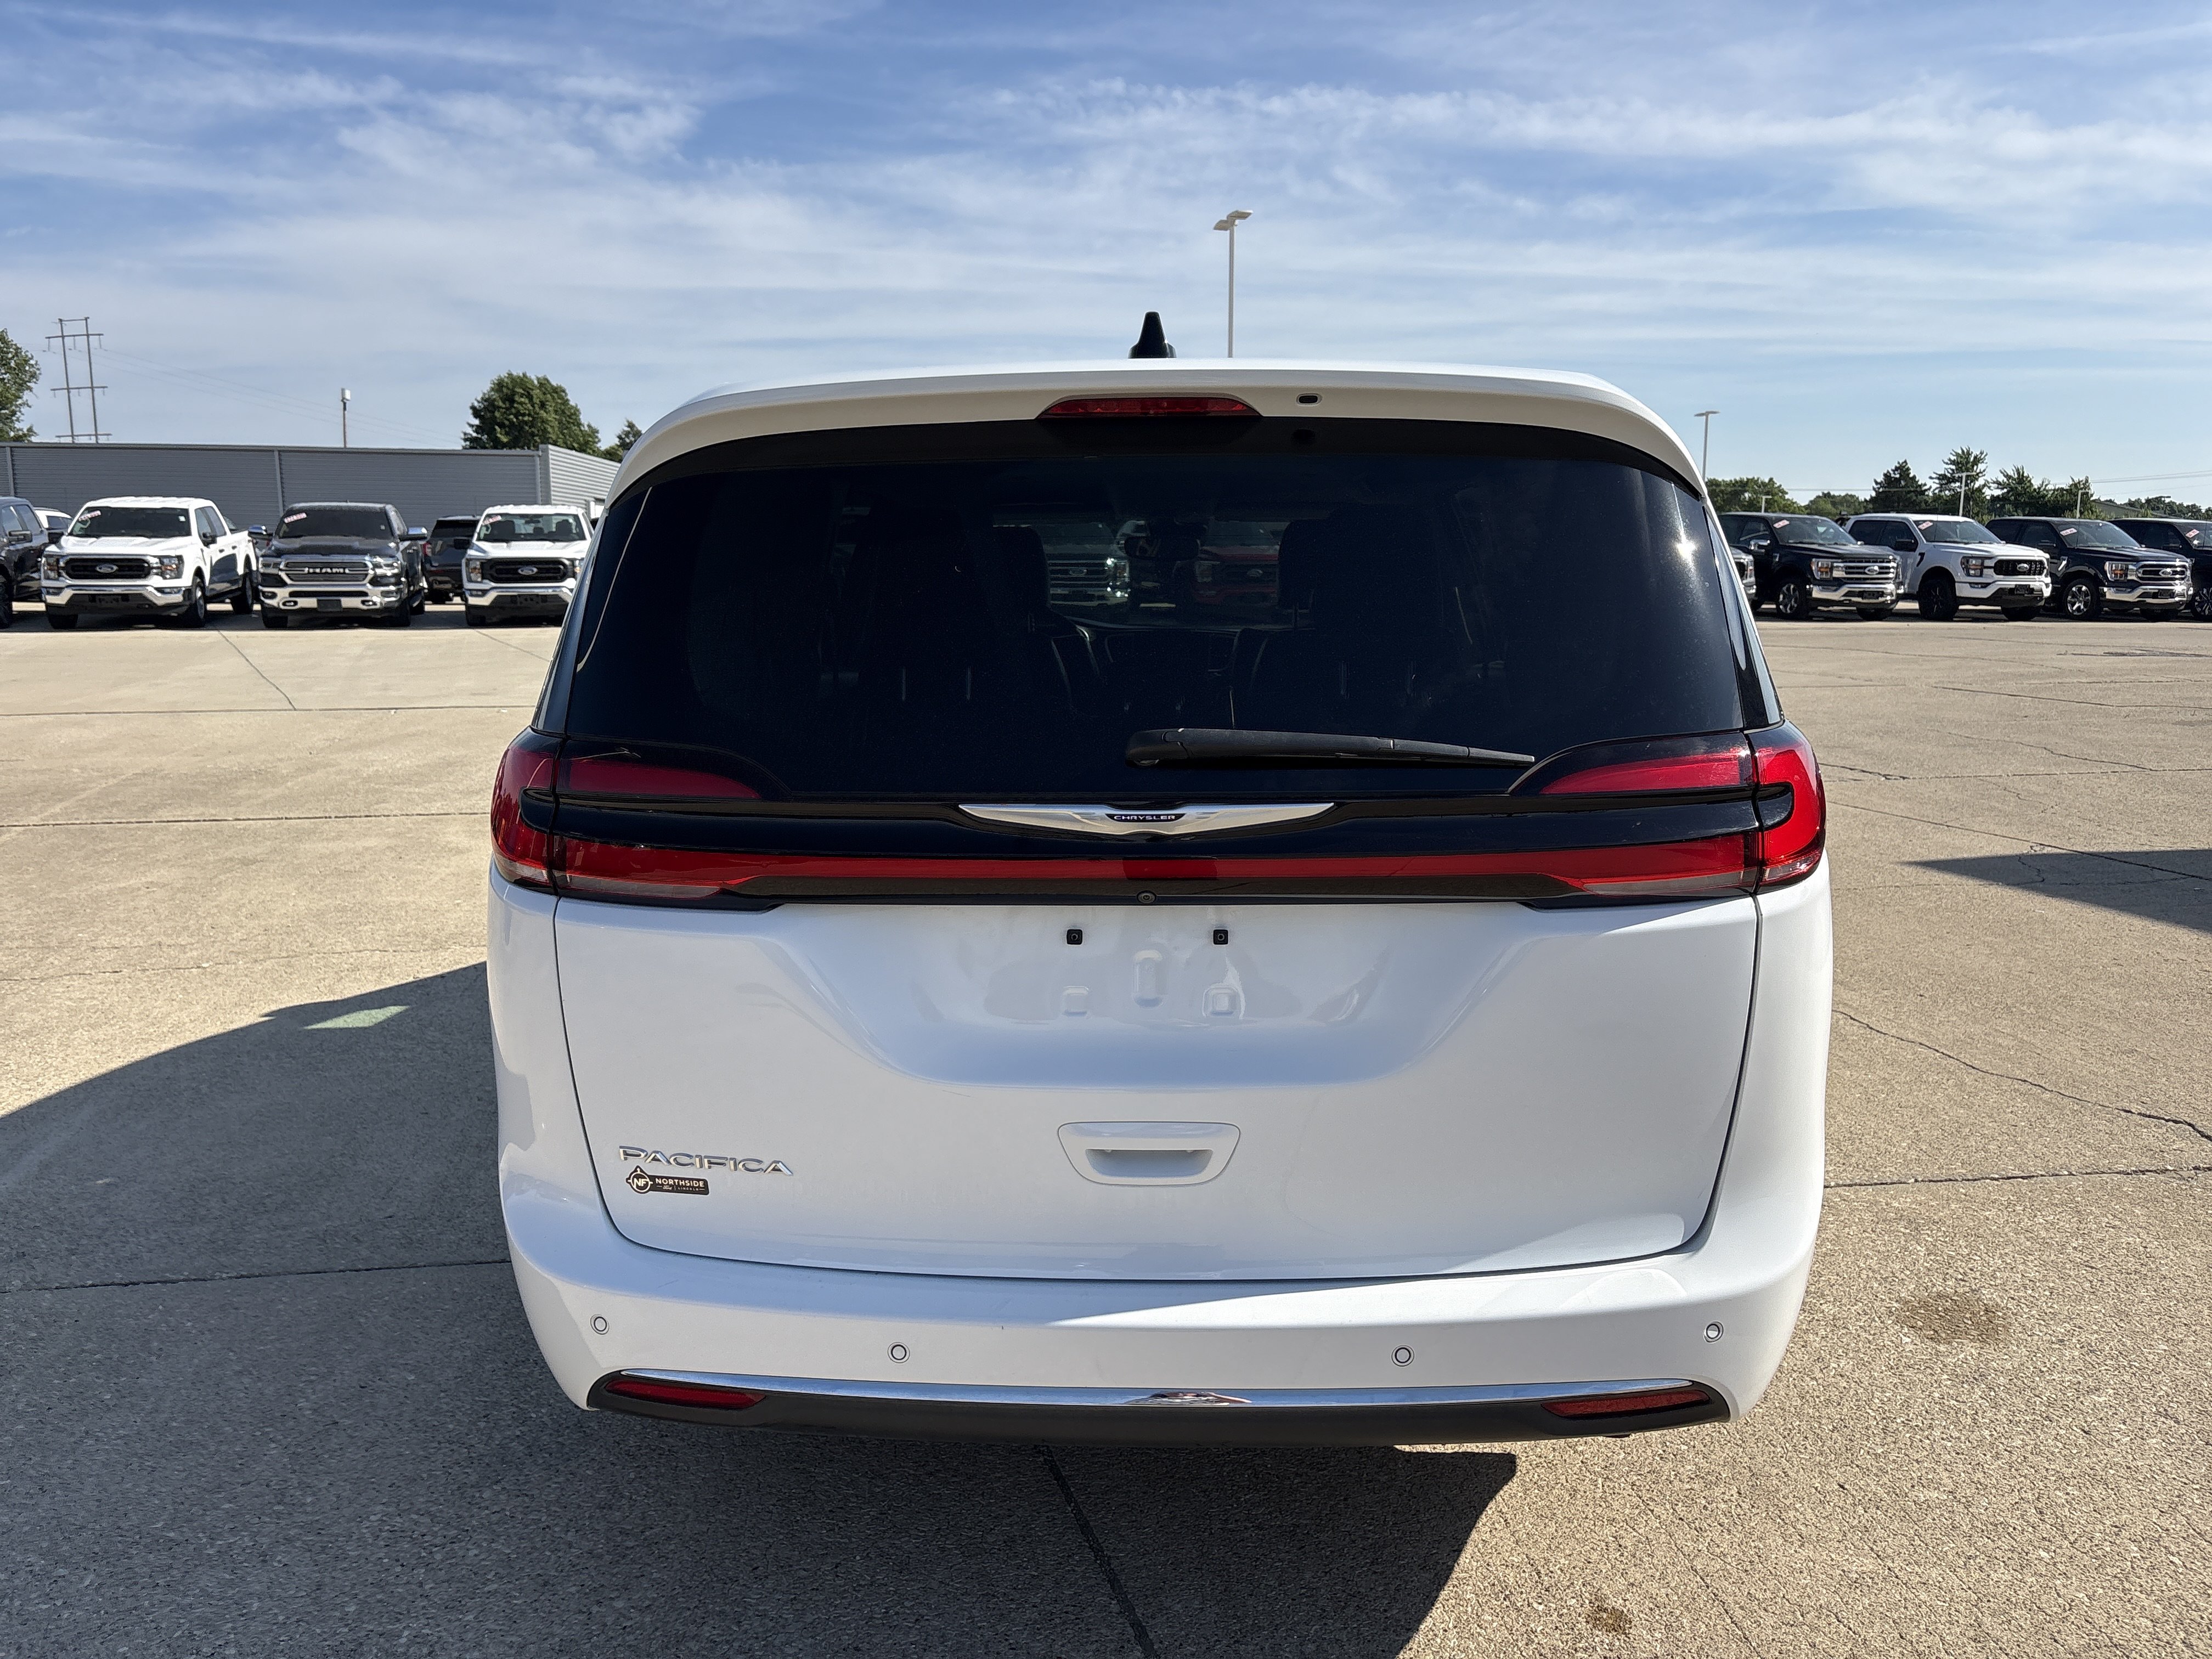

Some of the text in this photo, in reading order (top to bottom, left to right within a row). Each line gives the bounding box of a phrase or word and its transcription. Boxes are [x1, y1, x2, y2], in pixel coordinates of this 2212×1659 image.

[619, 1146, 793, 1176] PACIFICA
[634, 1178, 647, 1188] NF
[655, 1178, 705, 1187] NORTHSIDE
